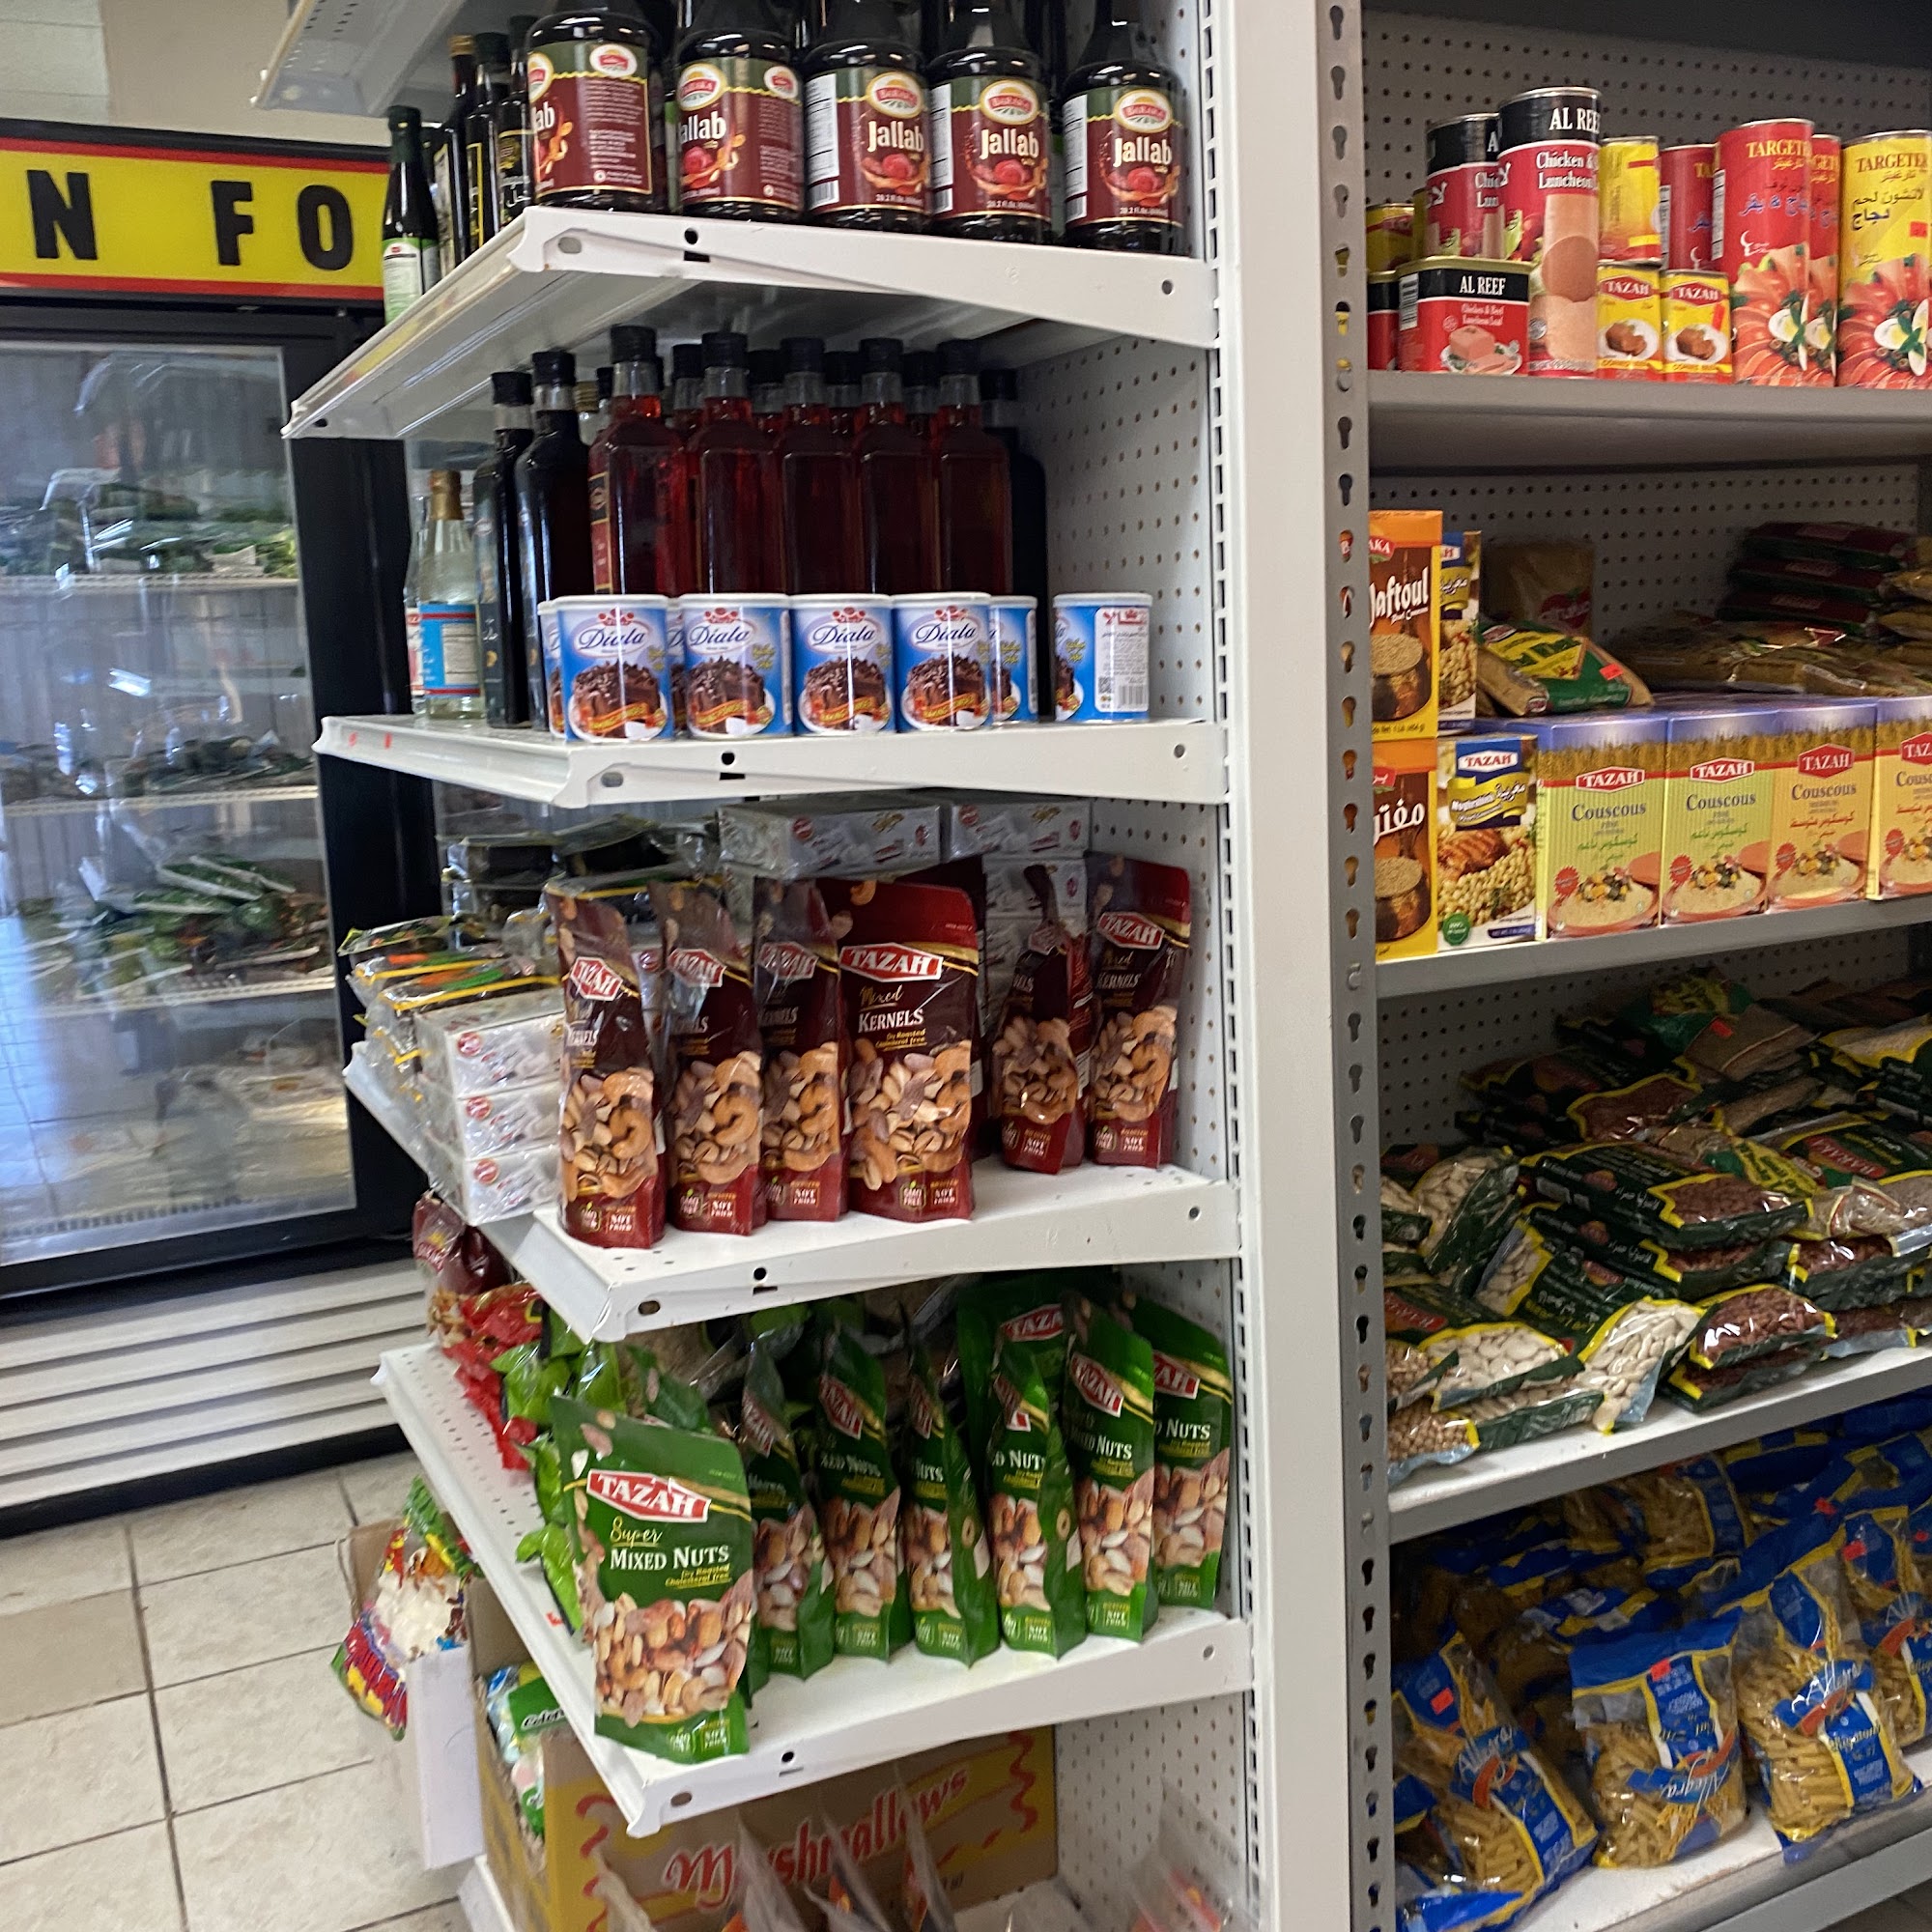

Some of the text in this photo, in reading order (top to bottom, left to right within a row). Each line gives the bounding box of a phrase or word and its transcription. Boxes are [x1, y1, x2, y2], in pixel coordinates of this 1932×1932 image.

[532, 100, 555, 131] lab
[1549, 108, 1600, 134] AL REE
[867, 120, 924, 153] Jallab
[980, 128, 1039, 159] Jallab
[1488, 132, 1498, 152] A
[1113, 136, 1173, 167] Jallab
[1536, 151, 1584, 169] Chicken
[27, 170, 98, 260] N
[1460, 276, 1506, 295] AL REEF
[1606, 279, 1650, 296] TAZAH
[1676, 286, 1720, 301] TAZAH
[1369, 538, 1391, 554] AKA
[579, 626, 646, 650] Diala
[688, 626, 751, 647] Diala
[812, 622, 875, 645] Diala
[915, 622, 977, 644] Diala
[1464, 754, 1513, 767] TAZAH
[1803, 753, 1850, 771] TAZAH
[1904, 743, 1932, 759] TAZ
[1582, 772, 1639, 787] TAZAH
[1695, 762, 1748, 779] TAZAH
[1895, 771, 1932, 787] Cousc
[1686, 793, 1756, 811] Couscous
[1791, 782, 1857, 801] Couscous
[1571, 803, 1646, 821] Couscous
[1103, 915, 1157, 946] TAZAH
[850, 951, 931, 976] TAZAH
[859, 984, 904, 1007] Mixed
[858, 1008, 924, 1033] KERNELS
[1007, 1308, 1064, 1337] TAZA
[1154, 1361, 1189, 1392] ZAH
[1166, 1419, 1211, 1441] NUTS
[1097, 1435, 1133, 1460] NUTS
[598, 1473, 696, 1518] TAZAH
[610, 1516, 663, 1548] Super
[610, 1545, 730, 1571] MIXED NUTS
